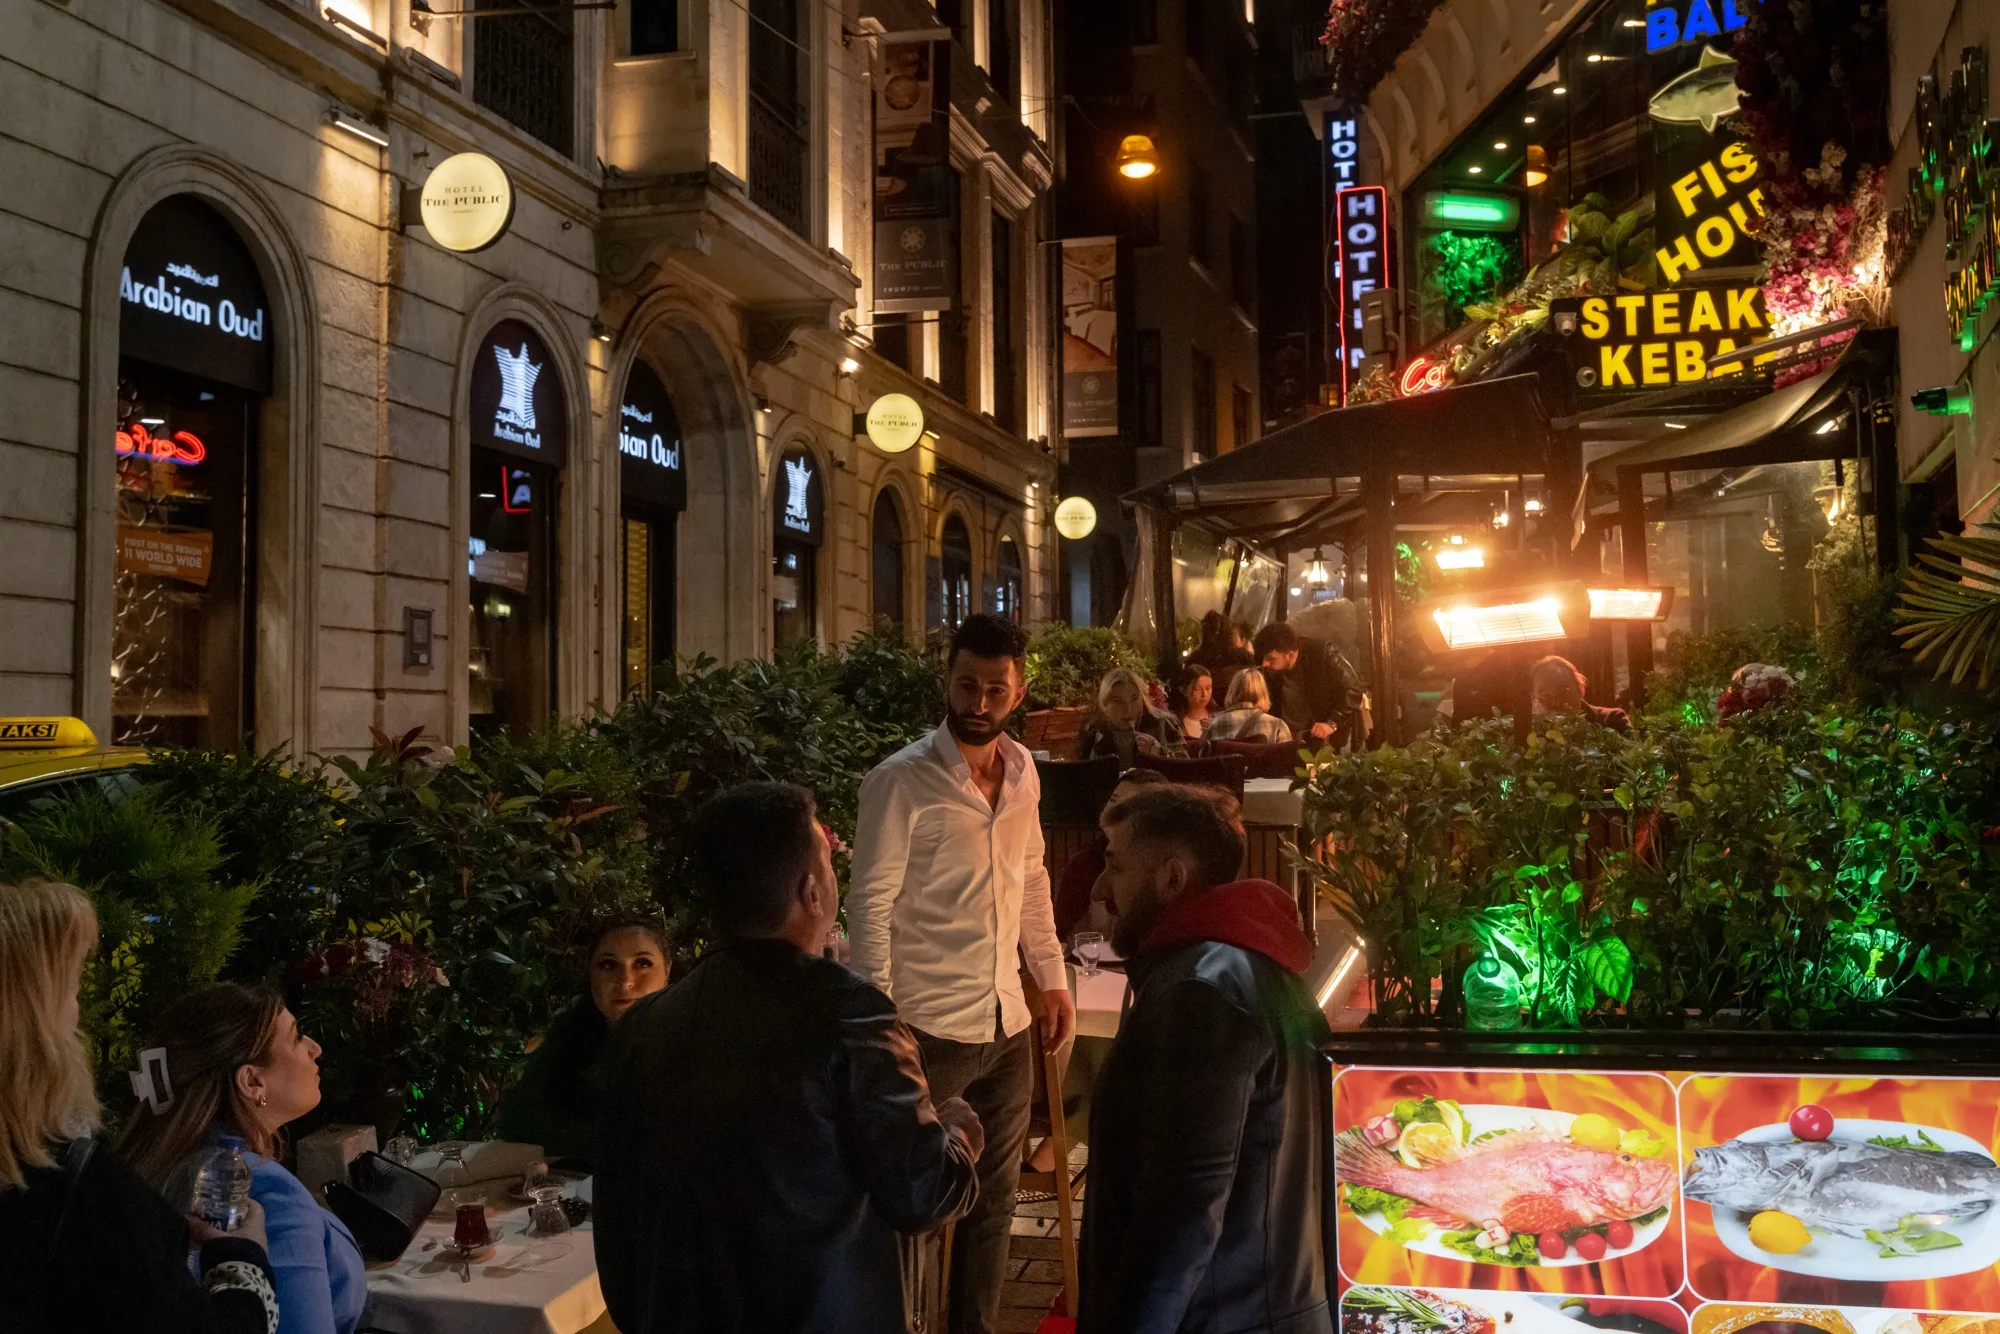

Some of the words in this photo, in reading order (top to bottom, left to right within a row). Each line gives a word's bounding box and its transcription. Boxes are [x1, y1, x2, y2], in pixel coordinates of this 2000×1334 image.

[1647, 0, 1748, 51] BAL
[1331, 119, 1357, 196] HOT
[1671, 142, 1758, 217] FIS
[445, 186, 483, 194] HOTEL
[454, 195, 504, 206] PUBLIC
[1656, 189, 1765, 283] HOU
[120, 266, 211, 325] Arabian
[218, 300, 263, 341] Oud
[1581, 288, 1775, 339] STEAK
[651, 433, 679, 470] Oud
[135, 549, 173, 564] WORLD
[176, 554, 202, 568] WIDE
